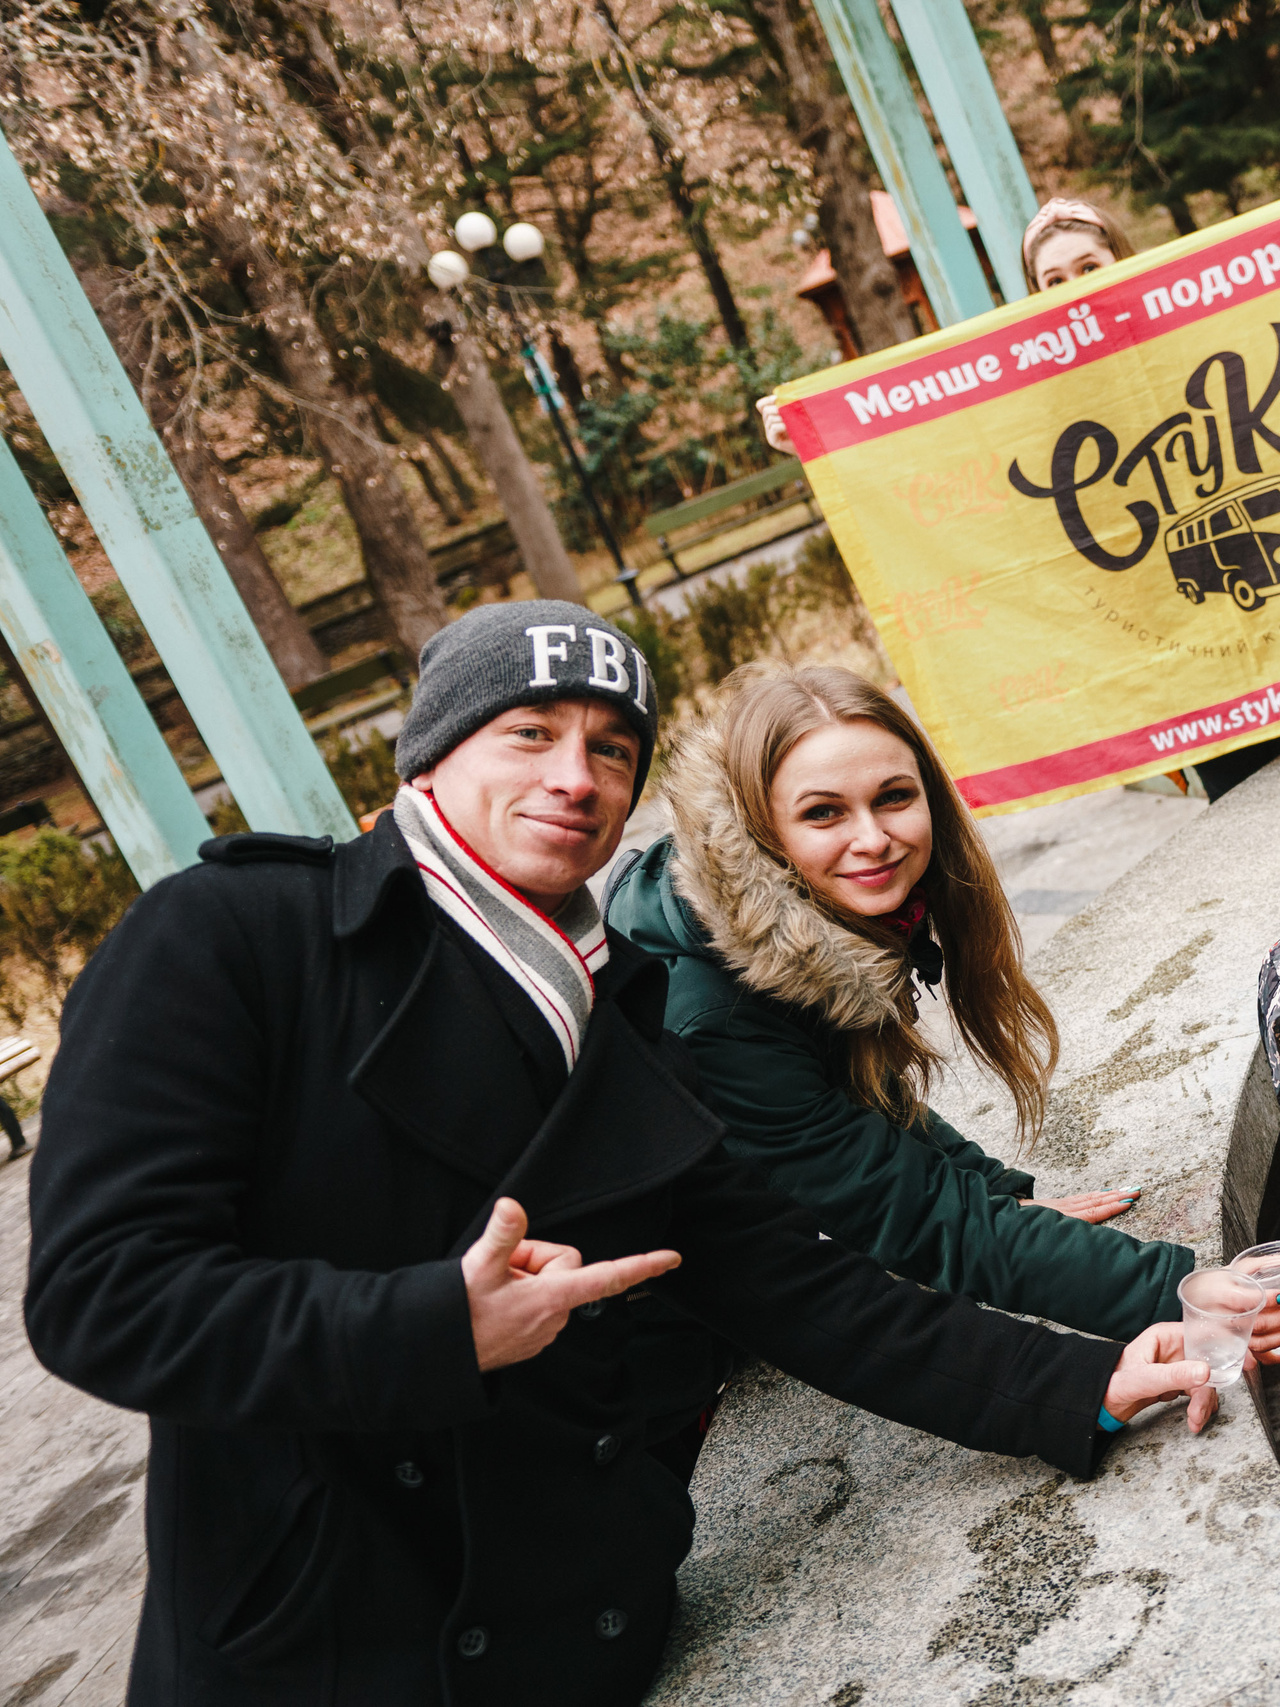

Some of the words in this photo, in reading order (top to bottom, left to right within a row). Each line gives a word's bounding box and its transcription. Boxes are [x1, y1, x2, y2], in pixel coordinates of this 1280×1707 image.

[844, 353, 1002, 426] Менше
[1010, 303, 1105, 366] жуй
[1084, 585, 1249, 659] туристичний
[524, 624, 649, 715] FBI
